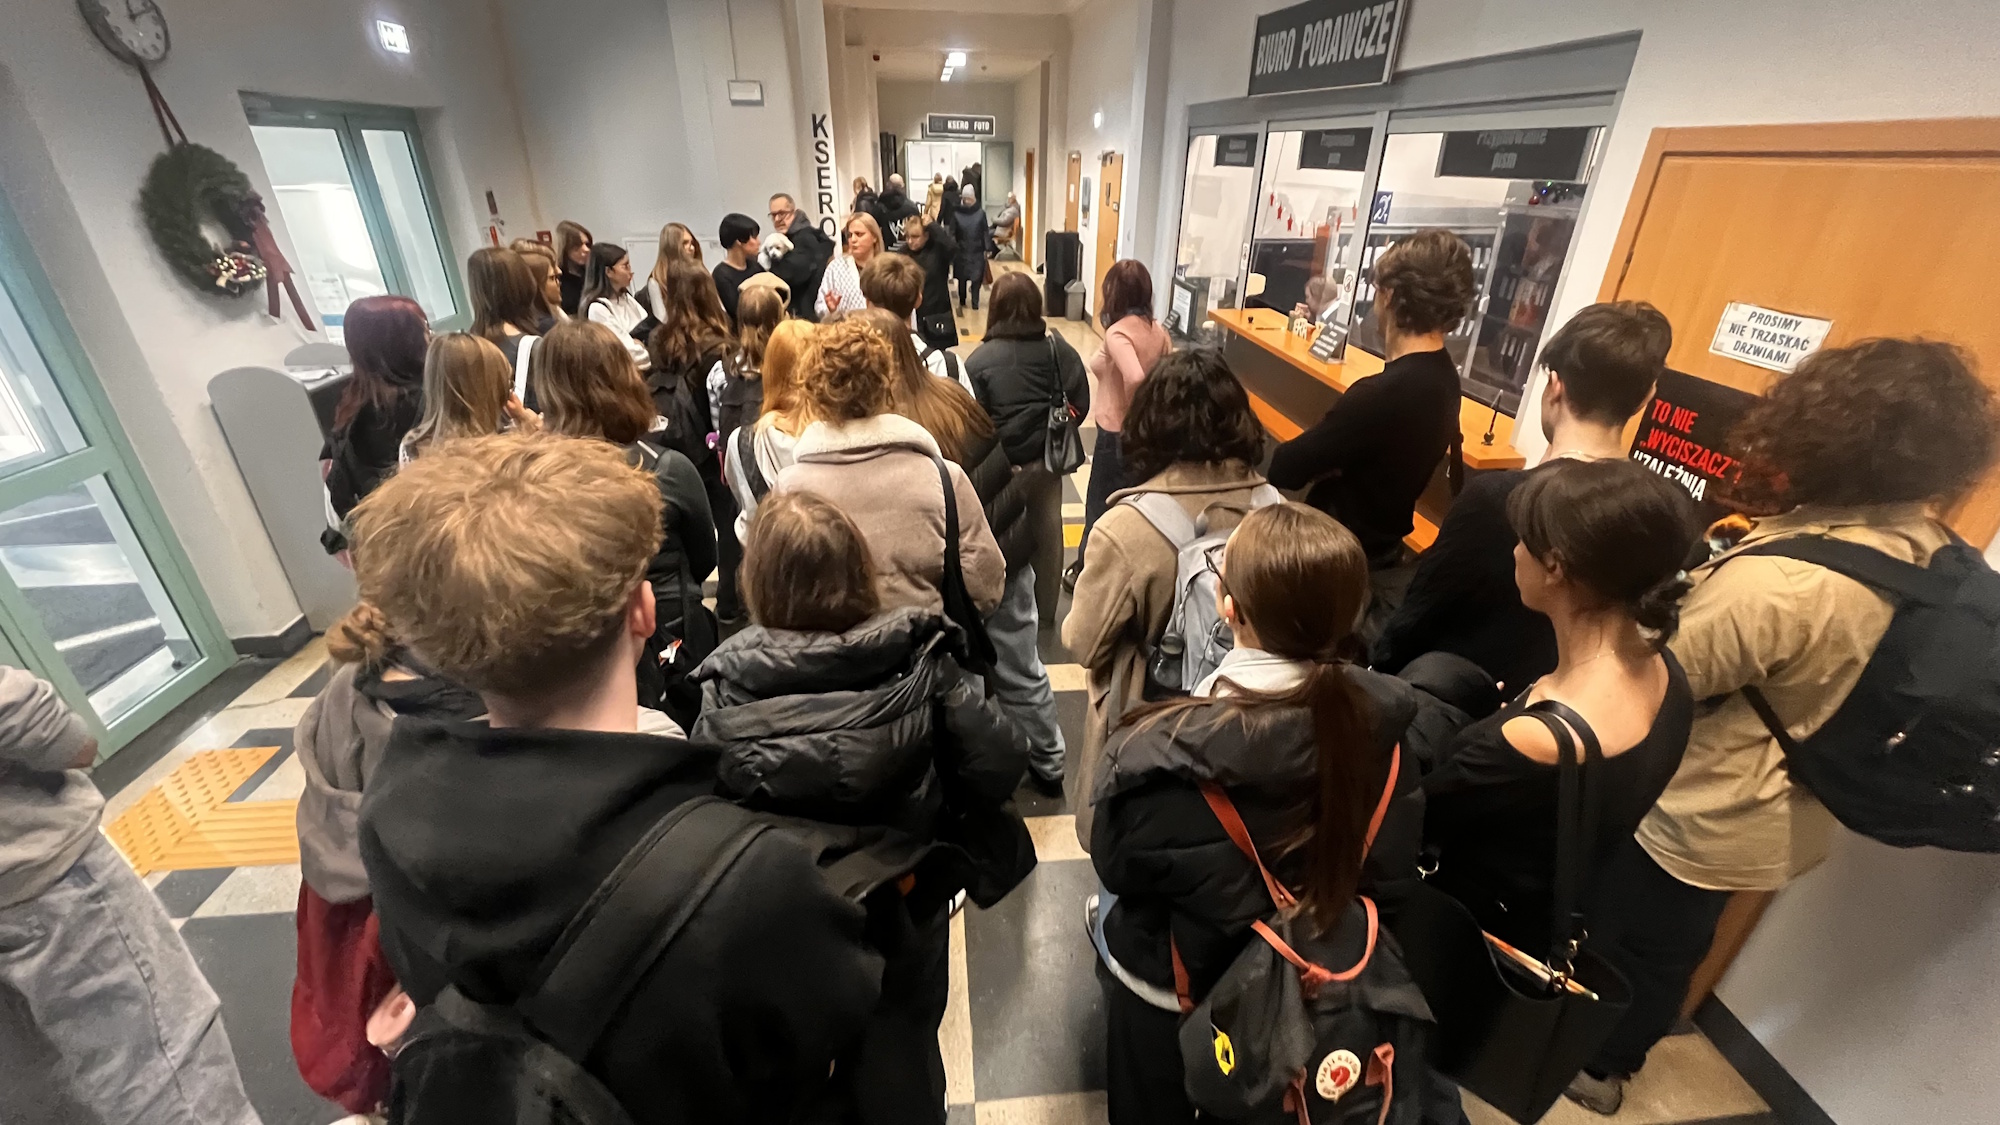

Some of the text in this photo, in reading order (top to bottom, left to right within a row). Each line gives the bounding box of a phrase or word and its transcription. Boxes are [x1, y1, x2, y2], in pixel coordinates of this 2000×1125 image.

[1255, 0, 1396, 76] BIURO PODAWCZE
[947, 119, 990, 131] KSERO FOTO
[811, 113, 837, 238] KSERO
[1747, 311, 1802, 333] PROSIMY
[1728, 323, 1810, 351] NIE TRZASKAĆ
[1733, 340, 1792, 364] DRZWIAMI
[1651, 398, 1699, 434] TO NIE
